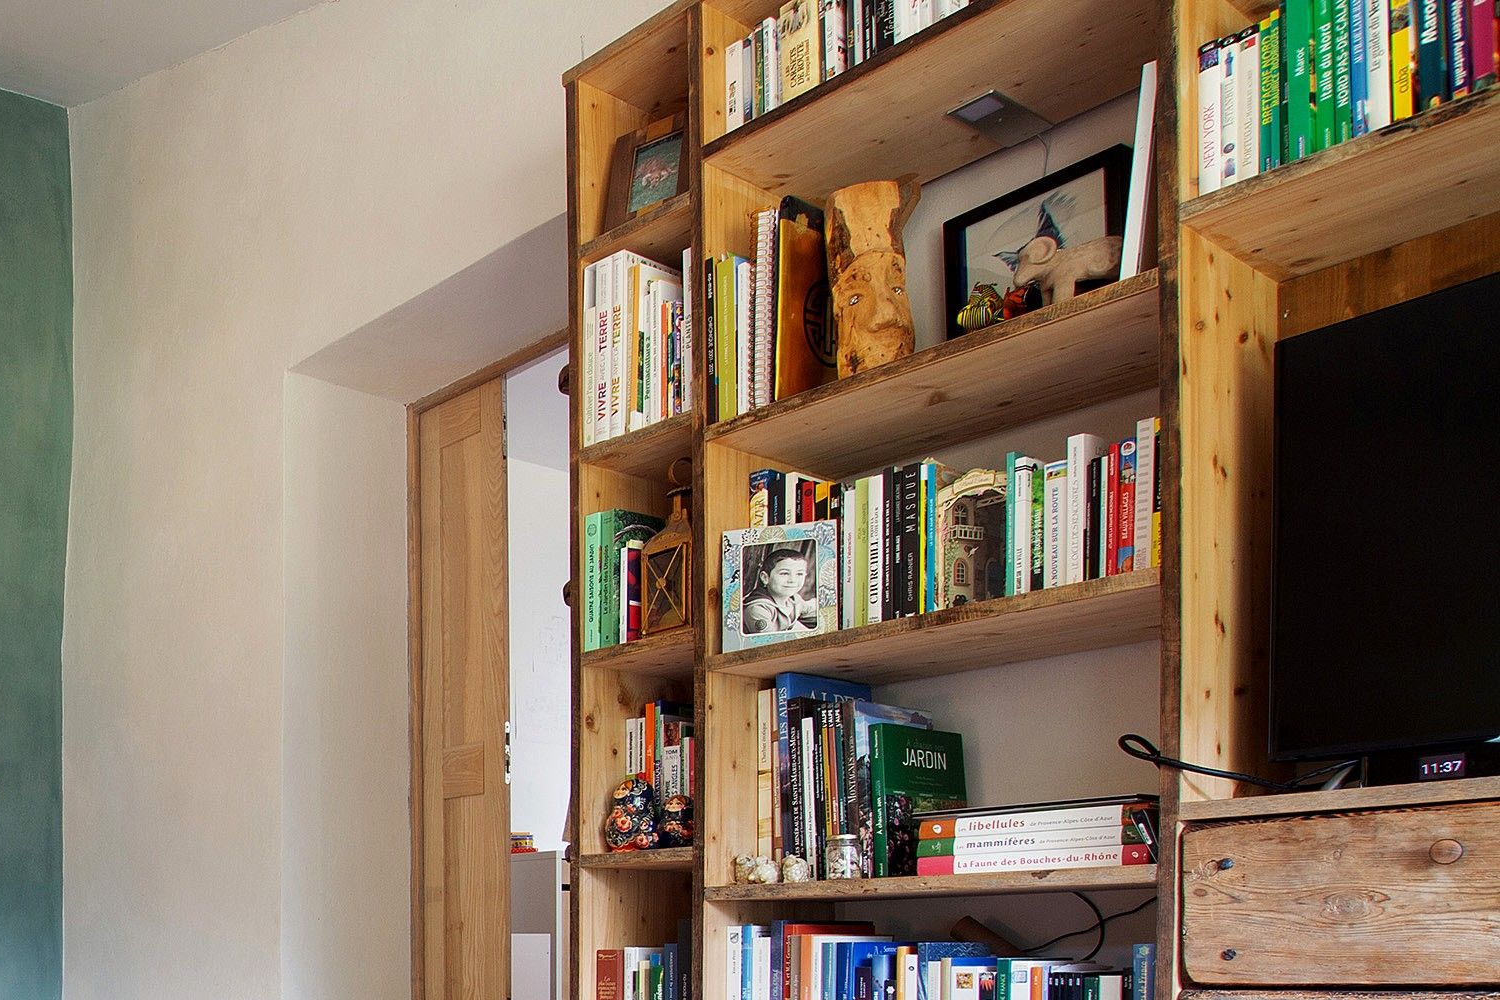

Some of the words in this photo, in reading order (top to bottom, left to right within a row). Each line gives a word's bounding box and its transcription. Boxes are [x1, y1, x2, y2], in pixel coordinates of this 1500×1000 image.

[1260, 35, 1273, 68] NORD
[1318, 22, 1333, 52] Nord
[797, 42, 805, 71] ROUTE
[1294, 47, 1306, 78] Maroc
[1319, 53, 1333, 69] du
[1452, 41, 1467, 86] Australia
[798, 72, 805, 86] DE
[1319, 70, 1333, 102] Italie
[1394, 66, 1410, 94] cuba
[1260, 70, 1273, 126] BRETAGNE
[1202, 103, 1215, 139] YORK
[1202, 138, 1215, 170] NEW
[598, 310, 608, 353] TERRE
[612, 304, 621, 348] TERRE
[598, 382, 607, 422] VIVRE
[610, 376, 620, 417] VIVRE
[905, 472, 917, 534] MASQUE
[1052, 515, 1059, 526] LA
[779, 687, 788, 718] ALPES
[780, 722, 788, 741] LES
[902, 748, 947, 770] JARDIN
[1420, 759, 1462, 775] 11:37
[968, 818, 1026, 831] libellules
[966, 837, 1036, 849] mammifères
[970, 860, 998, 868] Faune
[1000, 858, 1018, 867] des
[1139, 960, 1148, 984] France
[1139, 984, 1147, 994] de
